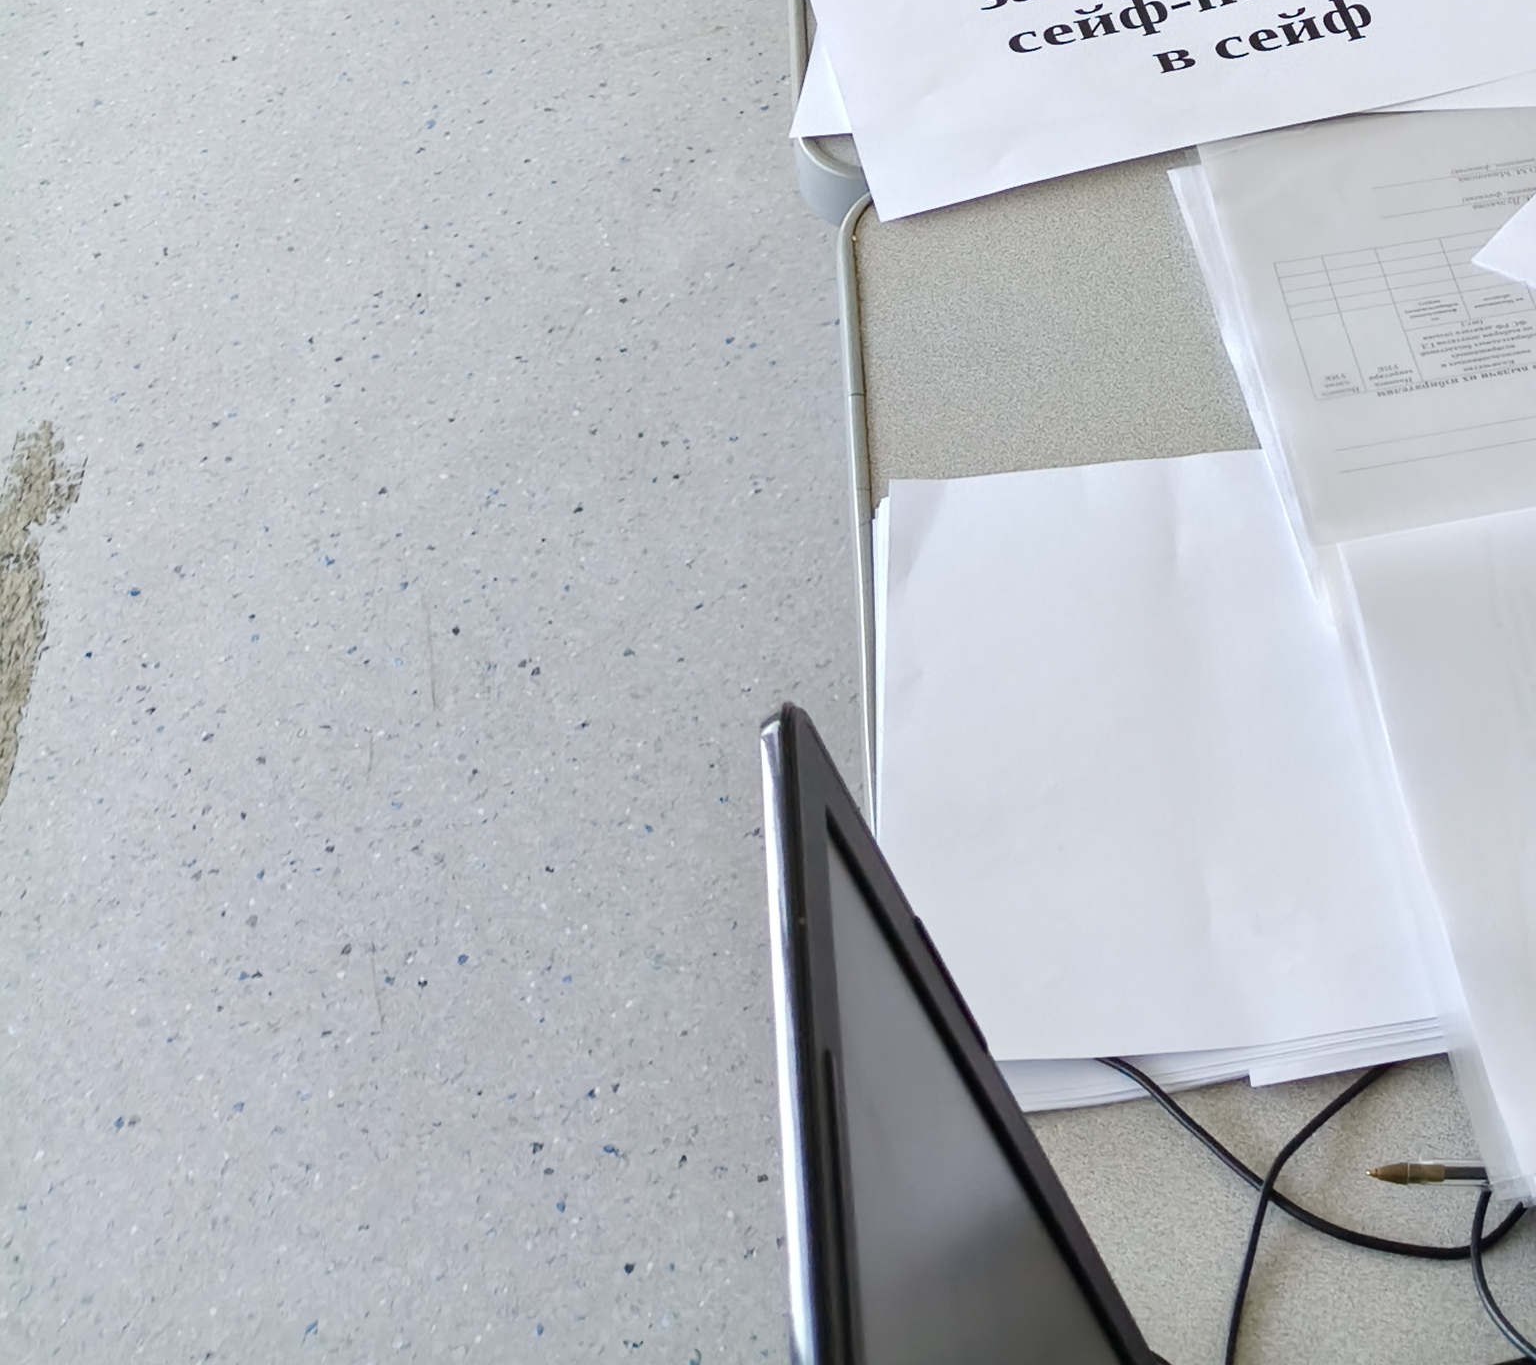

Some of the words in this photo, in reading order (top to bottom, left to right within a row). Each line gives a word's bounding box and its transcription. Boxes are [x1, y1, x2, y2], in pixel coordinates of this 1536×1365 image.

[1153, 49, 1196, 74] в
[1479, 364, 1528, 378] выдачи
[1375, 376, 1459, 398] избирателям
